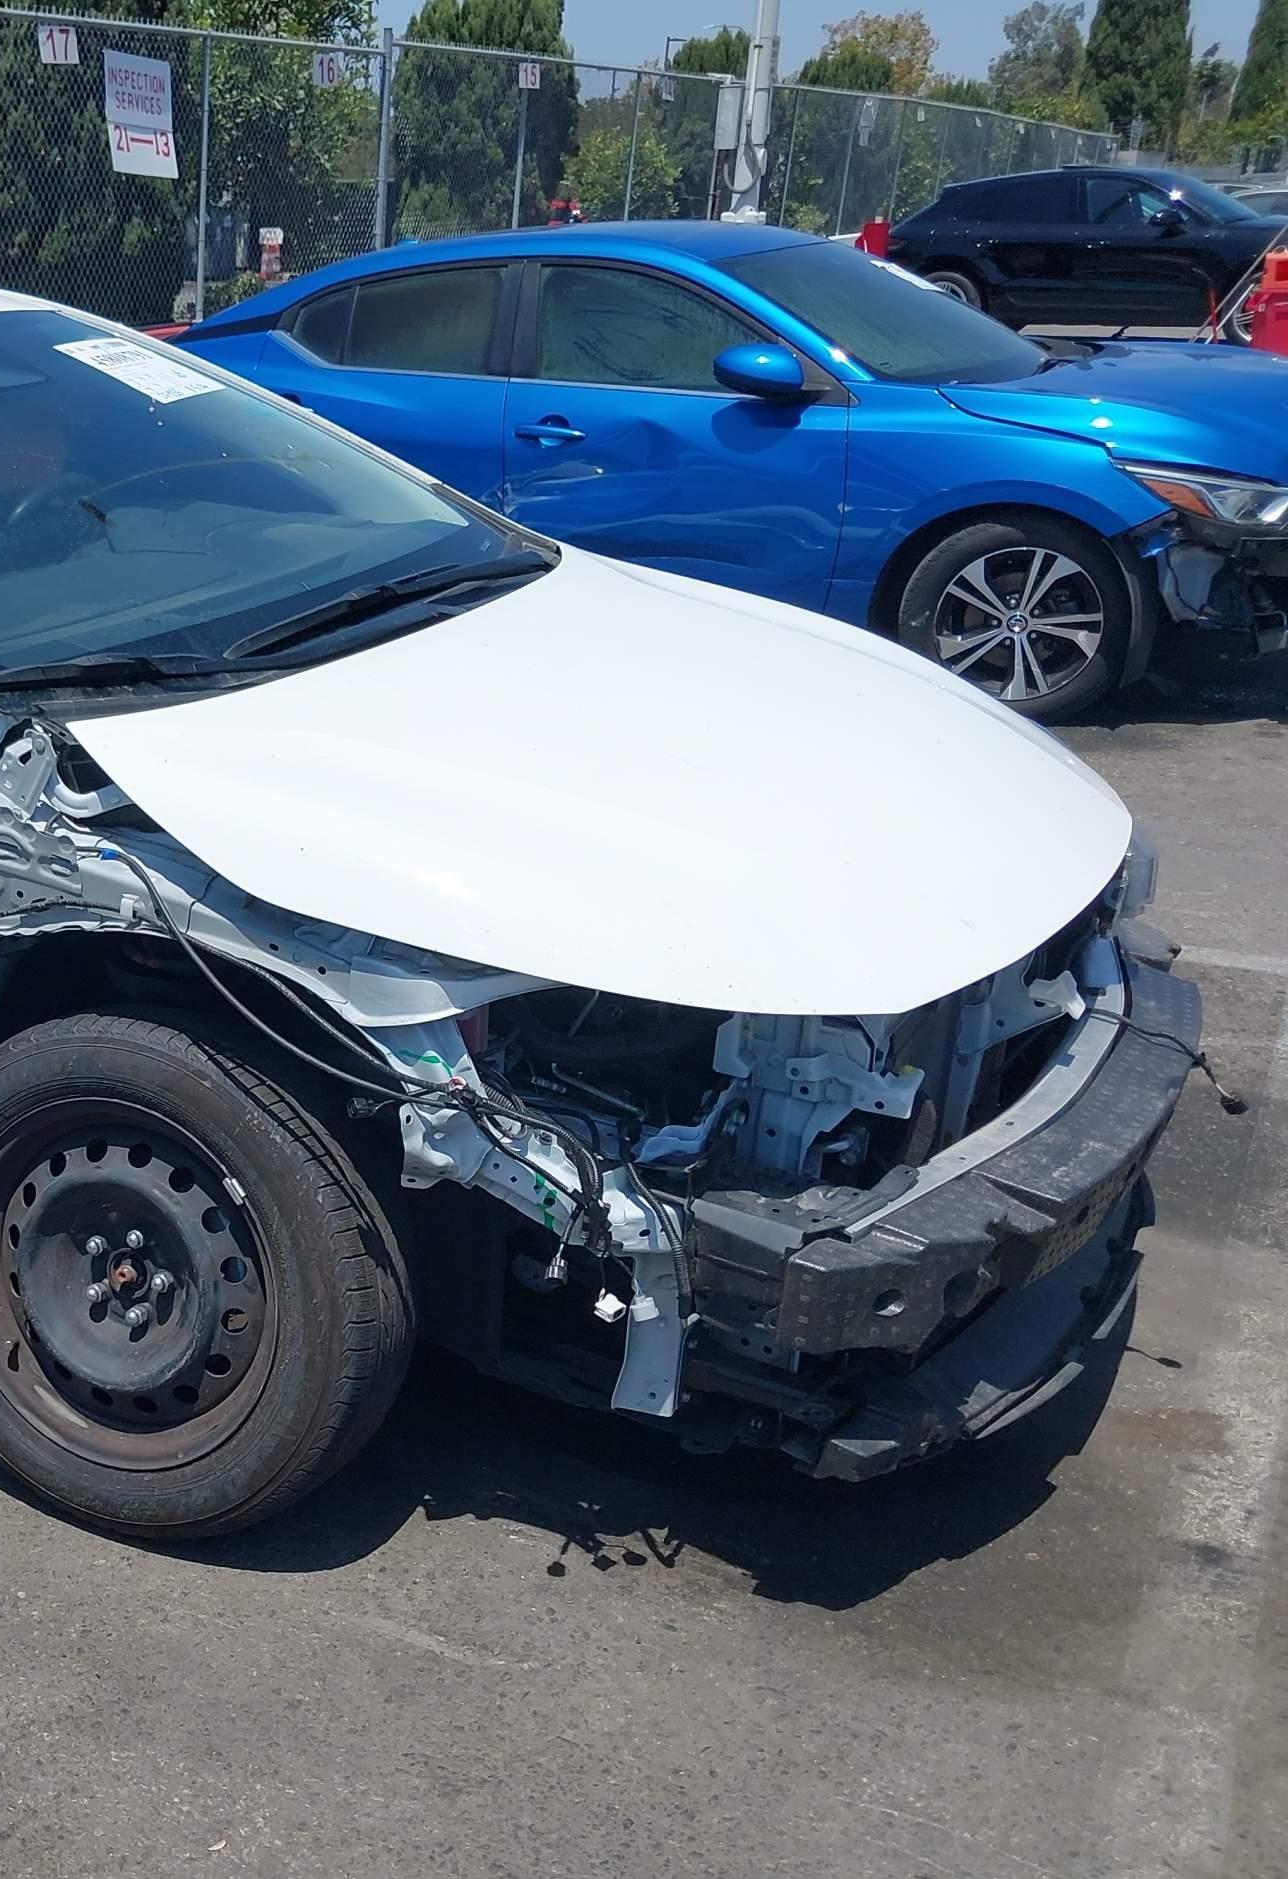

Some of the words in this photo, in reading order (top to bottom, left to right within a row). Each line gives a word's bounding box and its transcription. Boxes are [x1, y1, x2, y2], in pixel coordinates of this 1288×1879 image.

[46, 28, 70, 62] 17
[107, 66, 166, 95] INSPECTION
[318, 56, 335, 84] 16
[523, 64, 537, 87] 15
[115, 90, 163, 116] SERVICES
